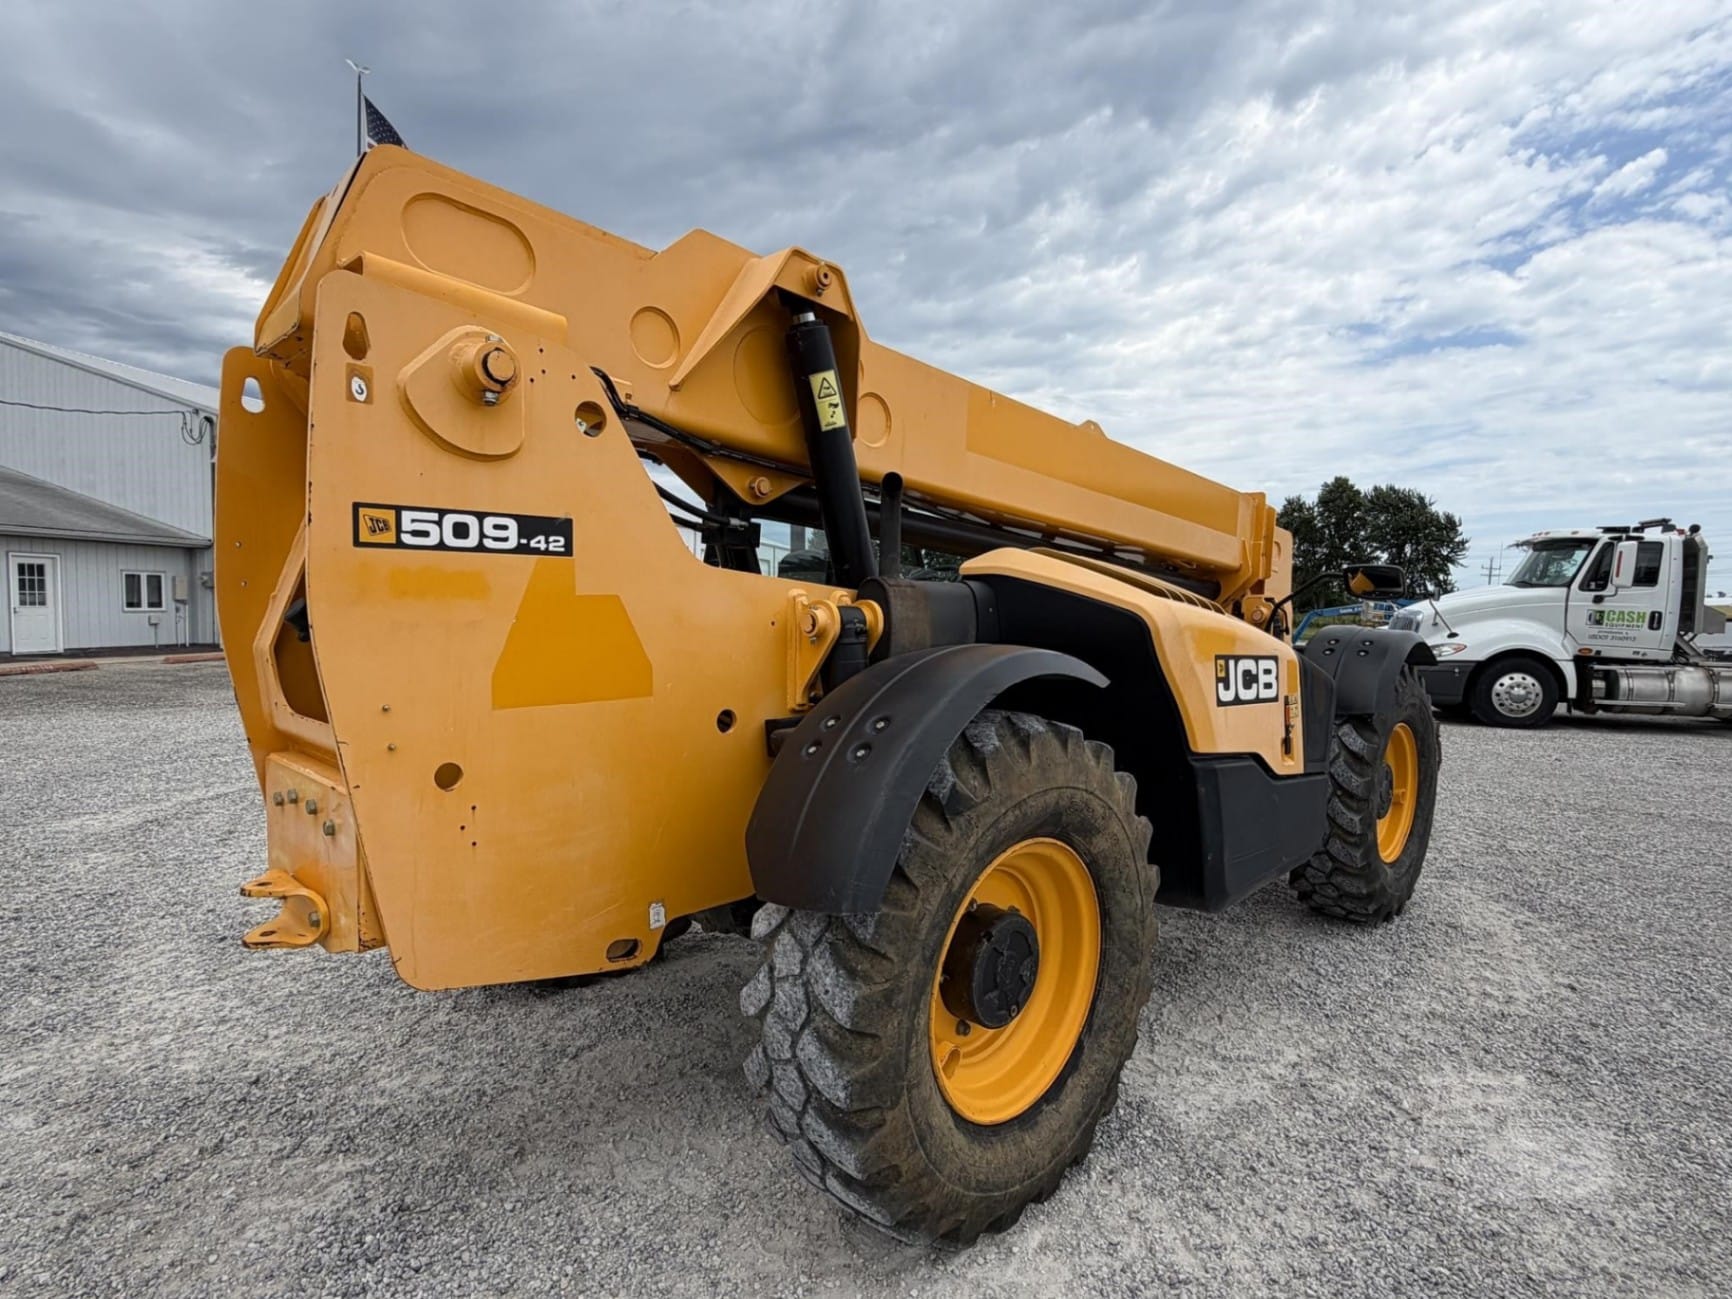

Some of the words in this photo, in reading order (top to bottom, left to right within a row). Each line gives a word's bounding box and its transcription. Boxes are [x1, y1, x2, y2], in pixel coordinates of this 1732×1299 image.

[401, 510, 566, 552] 509-42
[1606, 610, 1648, 624] CASH
[1217, 658, 1278, 702] JCB
